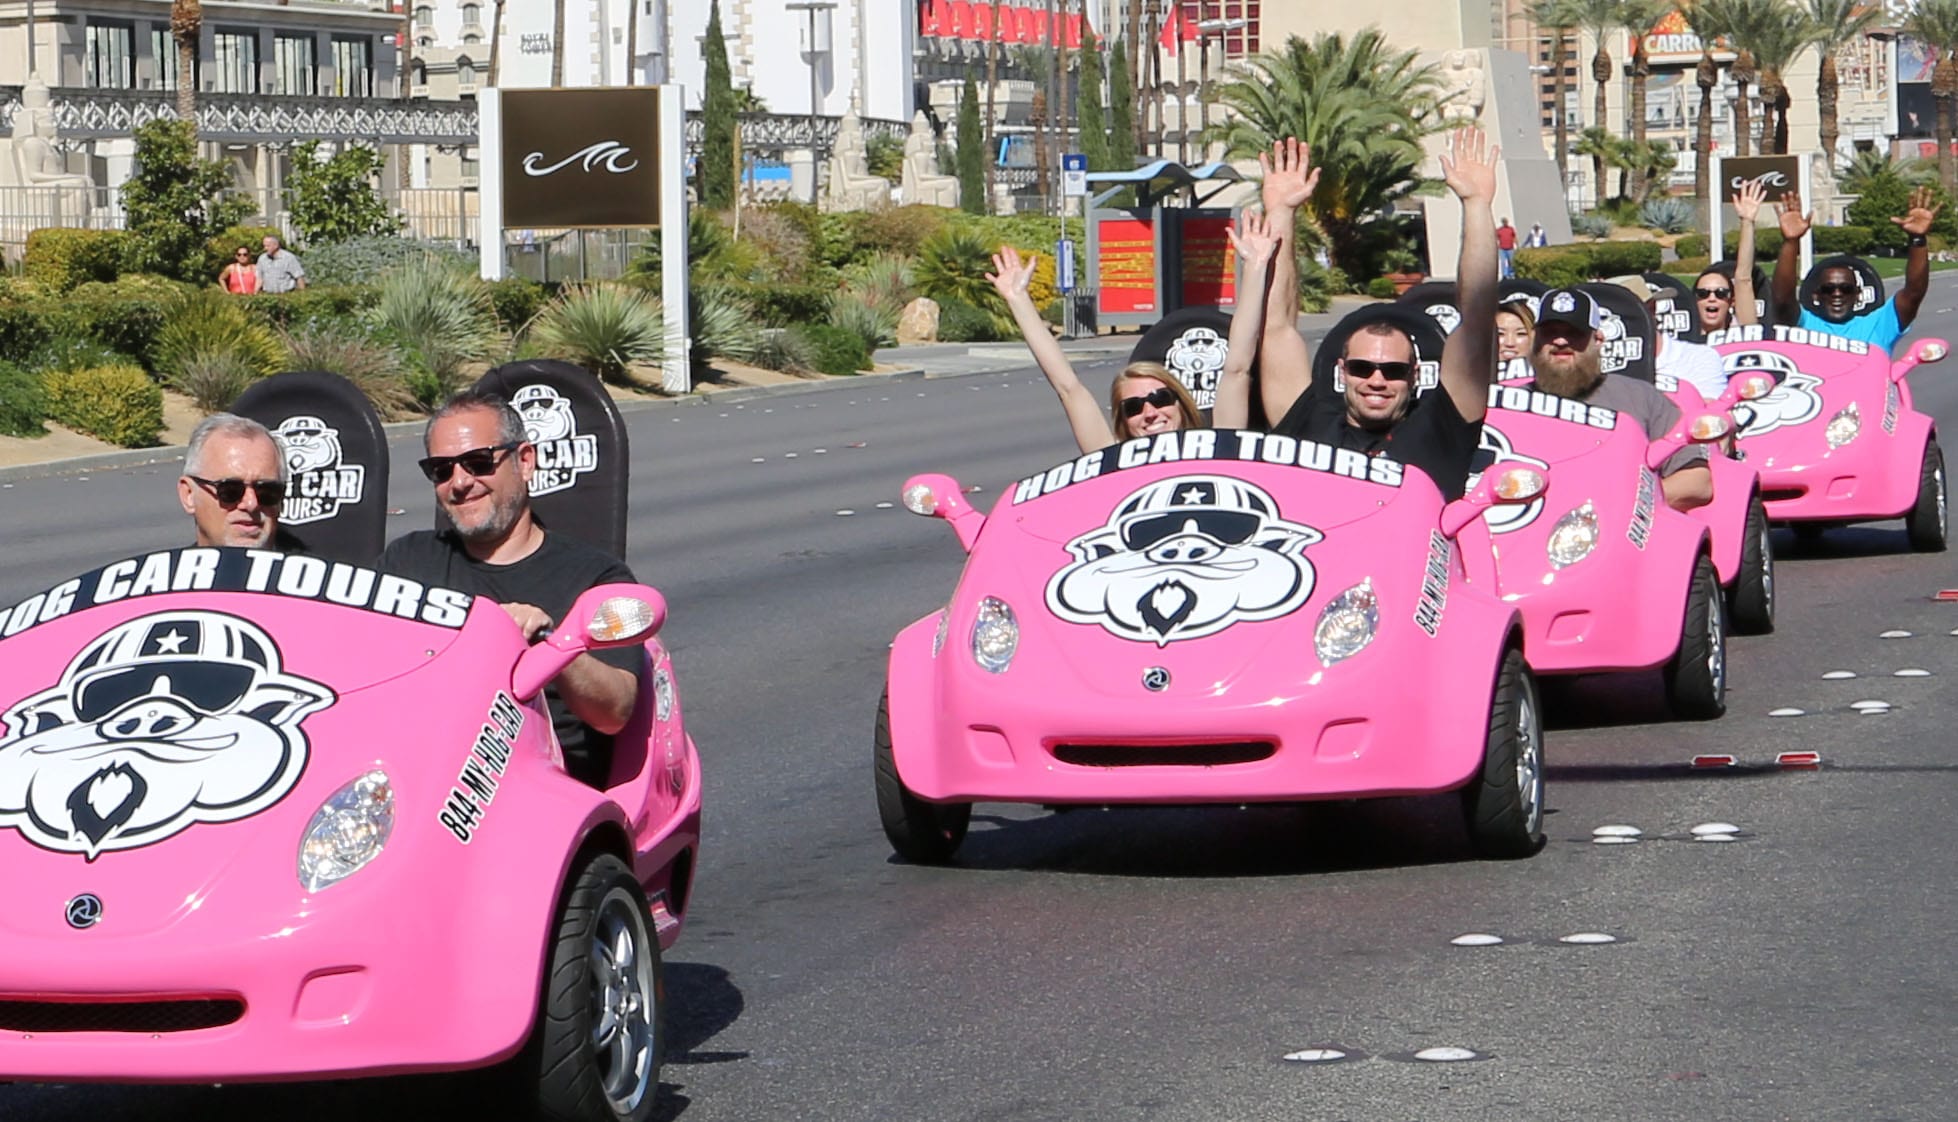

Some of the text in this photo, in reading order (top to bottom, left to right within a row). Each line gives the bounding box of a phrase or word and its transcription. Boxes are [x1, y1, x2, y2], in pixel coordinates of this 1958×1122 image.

[1707, 325, 1869, 355] CAR TOURS
[537, 439, 592, 469] CAR
[1013, 429, 1403, 505] HOG CAR TOURS
[300, 470, 358, 498] CAR
[93, 548, 221, 605] CAR
[245, 549, 473, 628] TOURS
[439, 691, 524, 842] 844-MY-HOG-CAR
